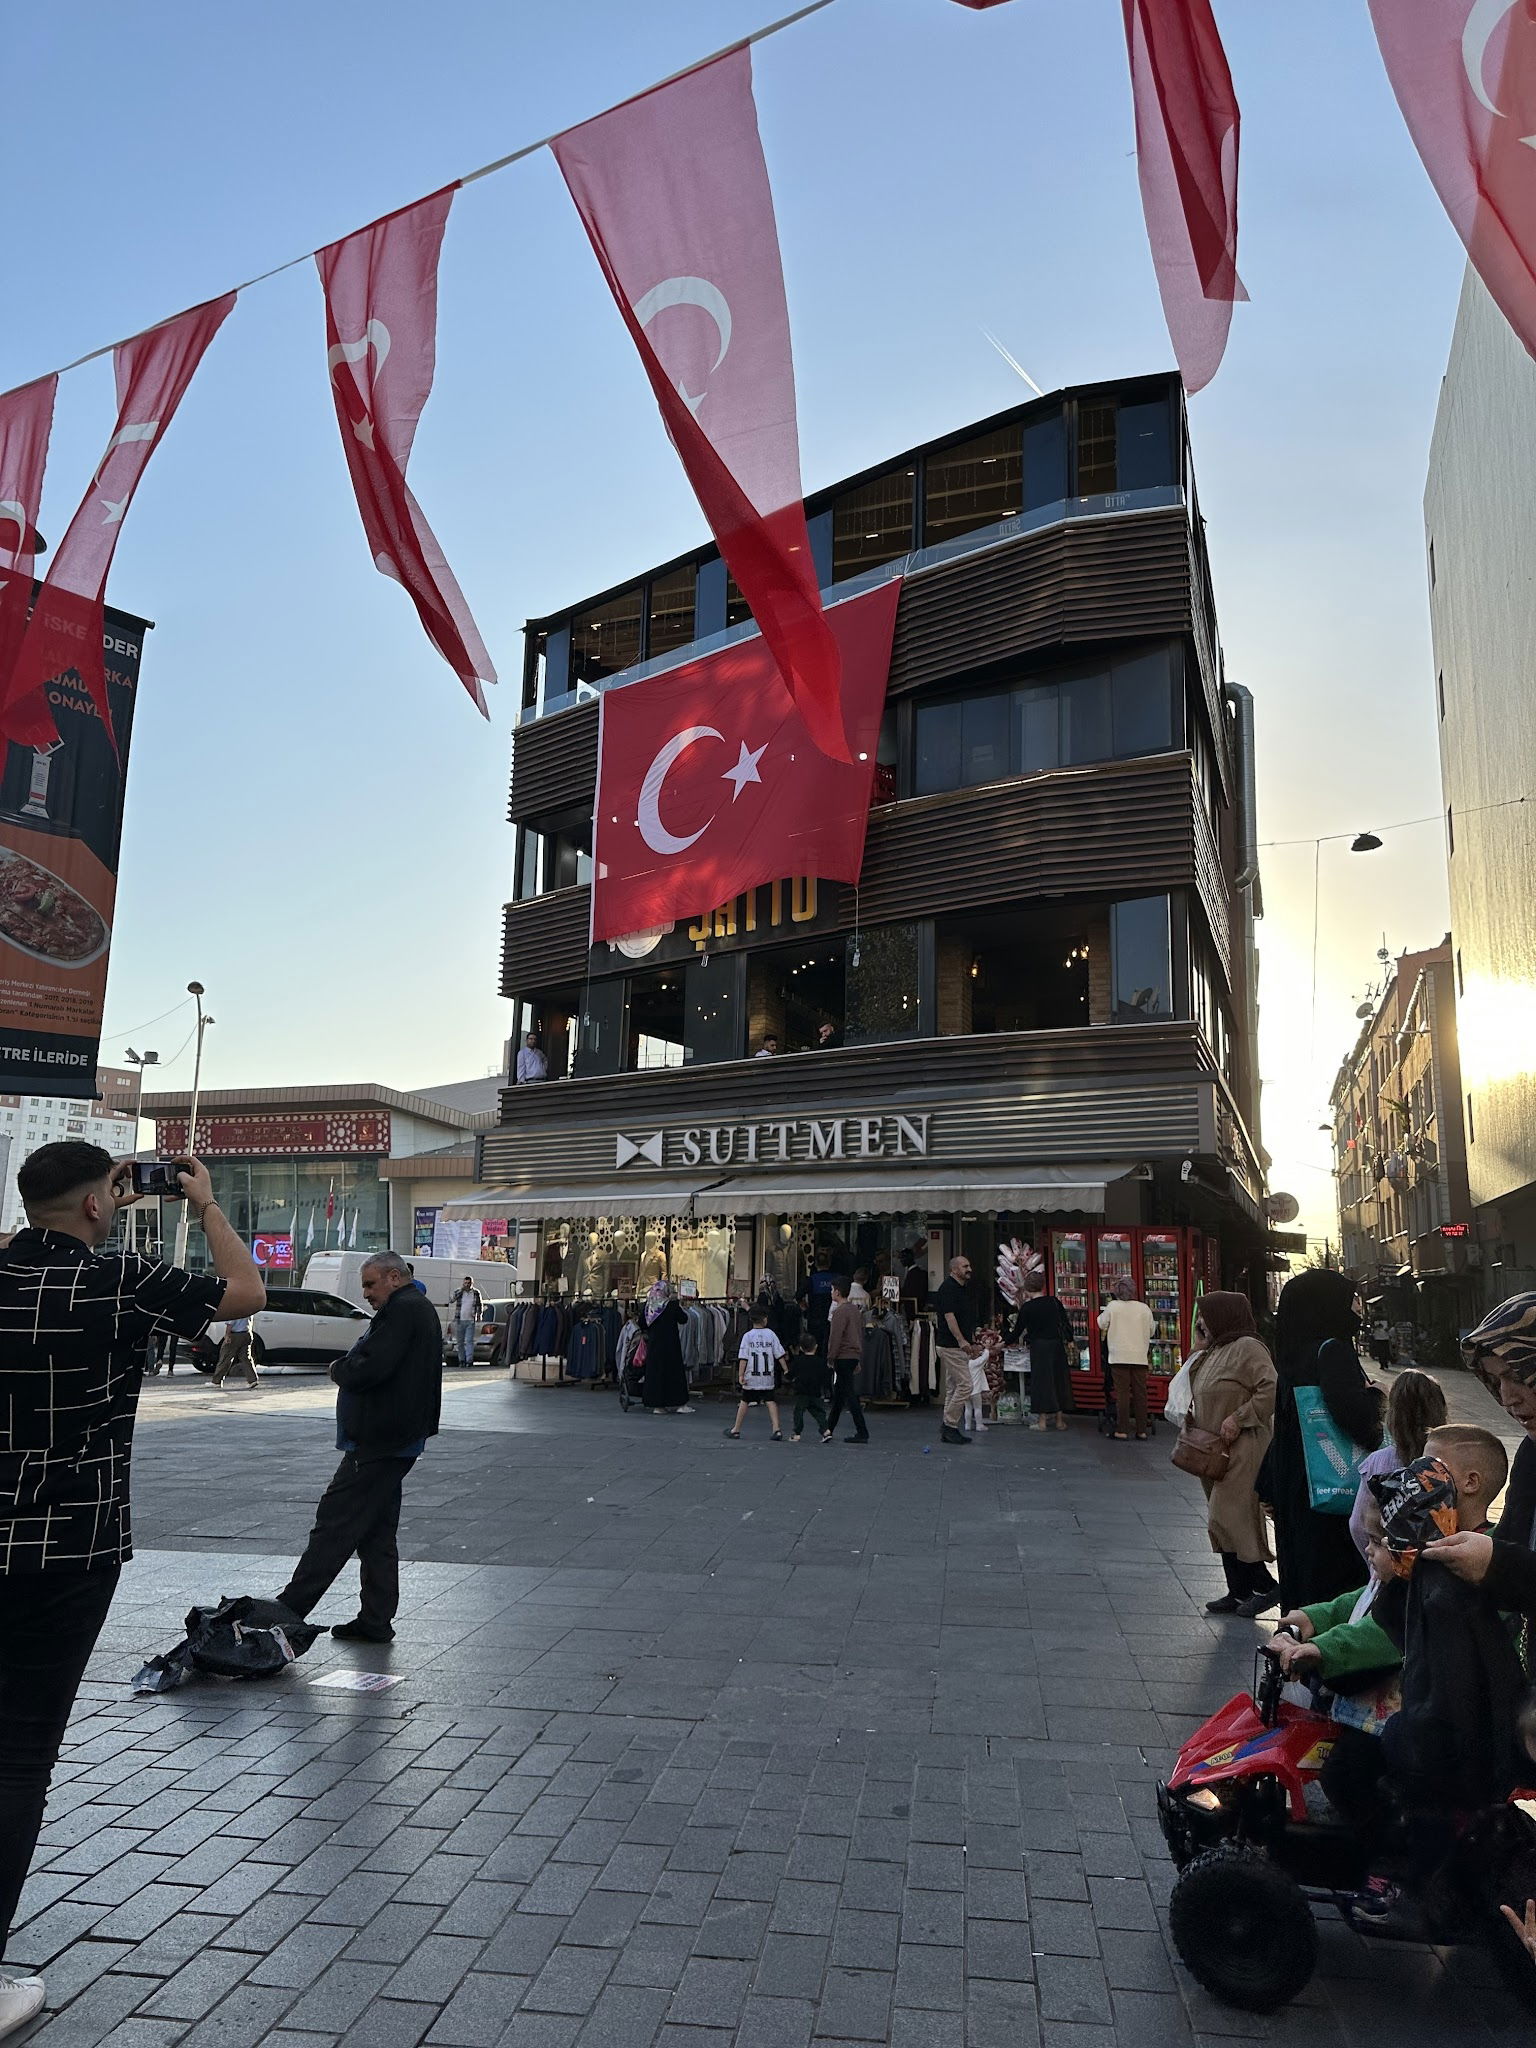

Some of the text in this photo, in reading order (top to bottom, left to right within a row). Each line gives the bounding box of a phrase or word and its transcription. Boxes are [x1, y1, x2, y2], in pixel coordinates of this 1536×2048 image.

[33, 1047, 89, 1066] İLERİDE
[682, 1114, 932, 1166] SUITMEN
[751, 1351, 772, 1377] 11
[1316, 1487, 1331, 1495] feel
